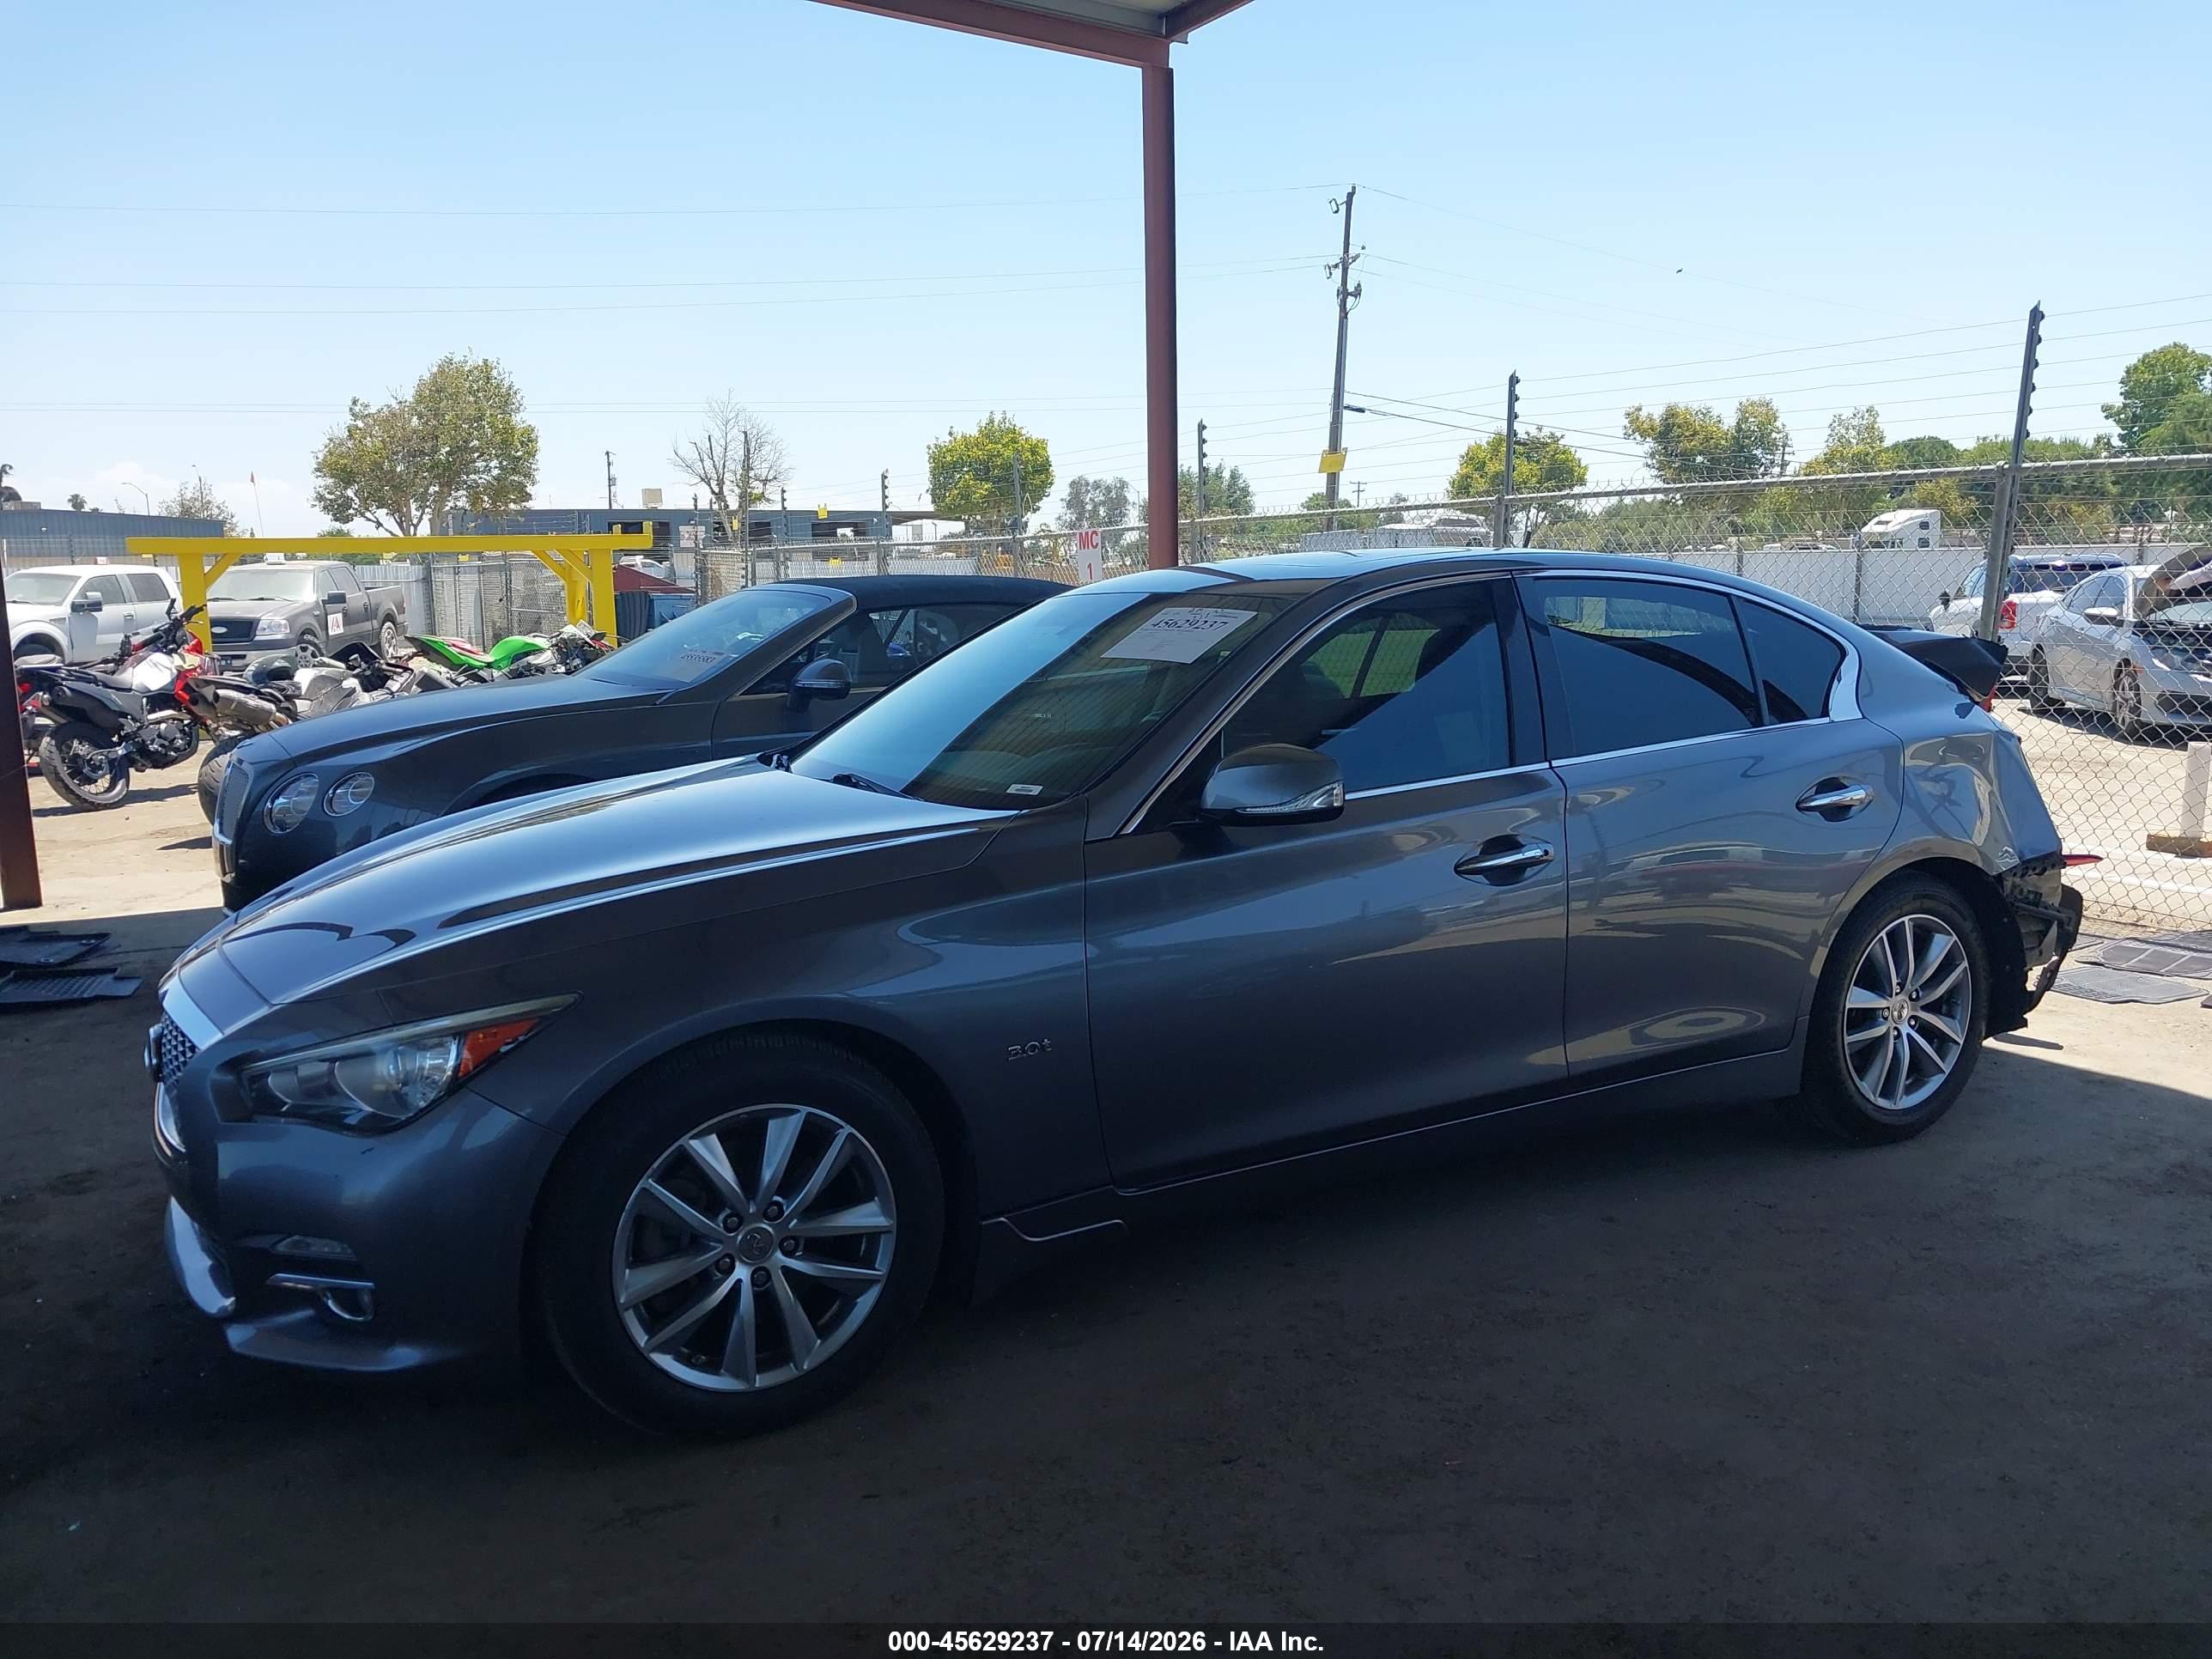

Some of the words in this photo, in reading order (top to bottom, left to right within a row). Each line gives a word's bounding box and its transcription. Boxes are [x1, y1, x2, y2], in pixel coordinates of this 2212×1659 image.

[1079, 530, 1099, 550] MC
[1086, 562, 1093, 580] 1
[1151, 618, 1231, 631] 45629237
